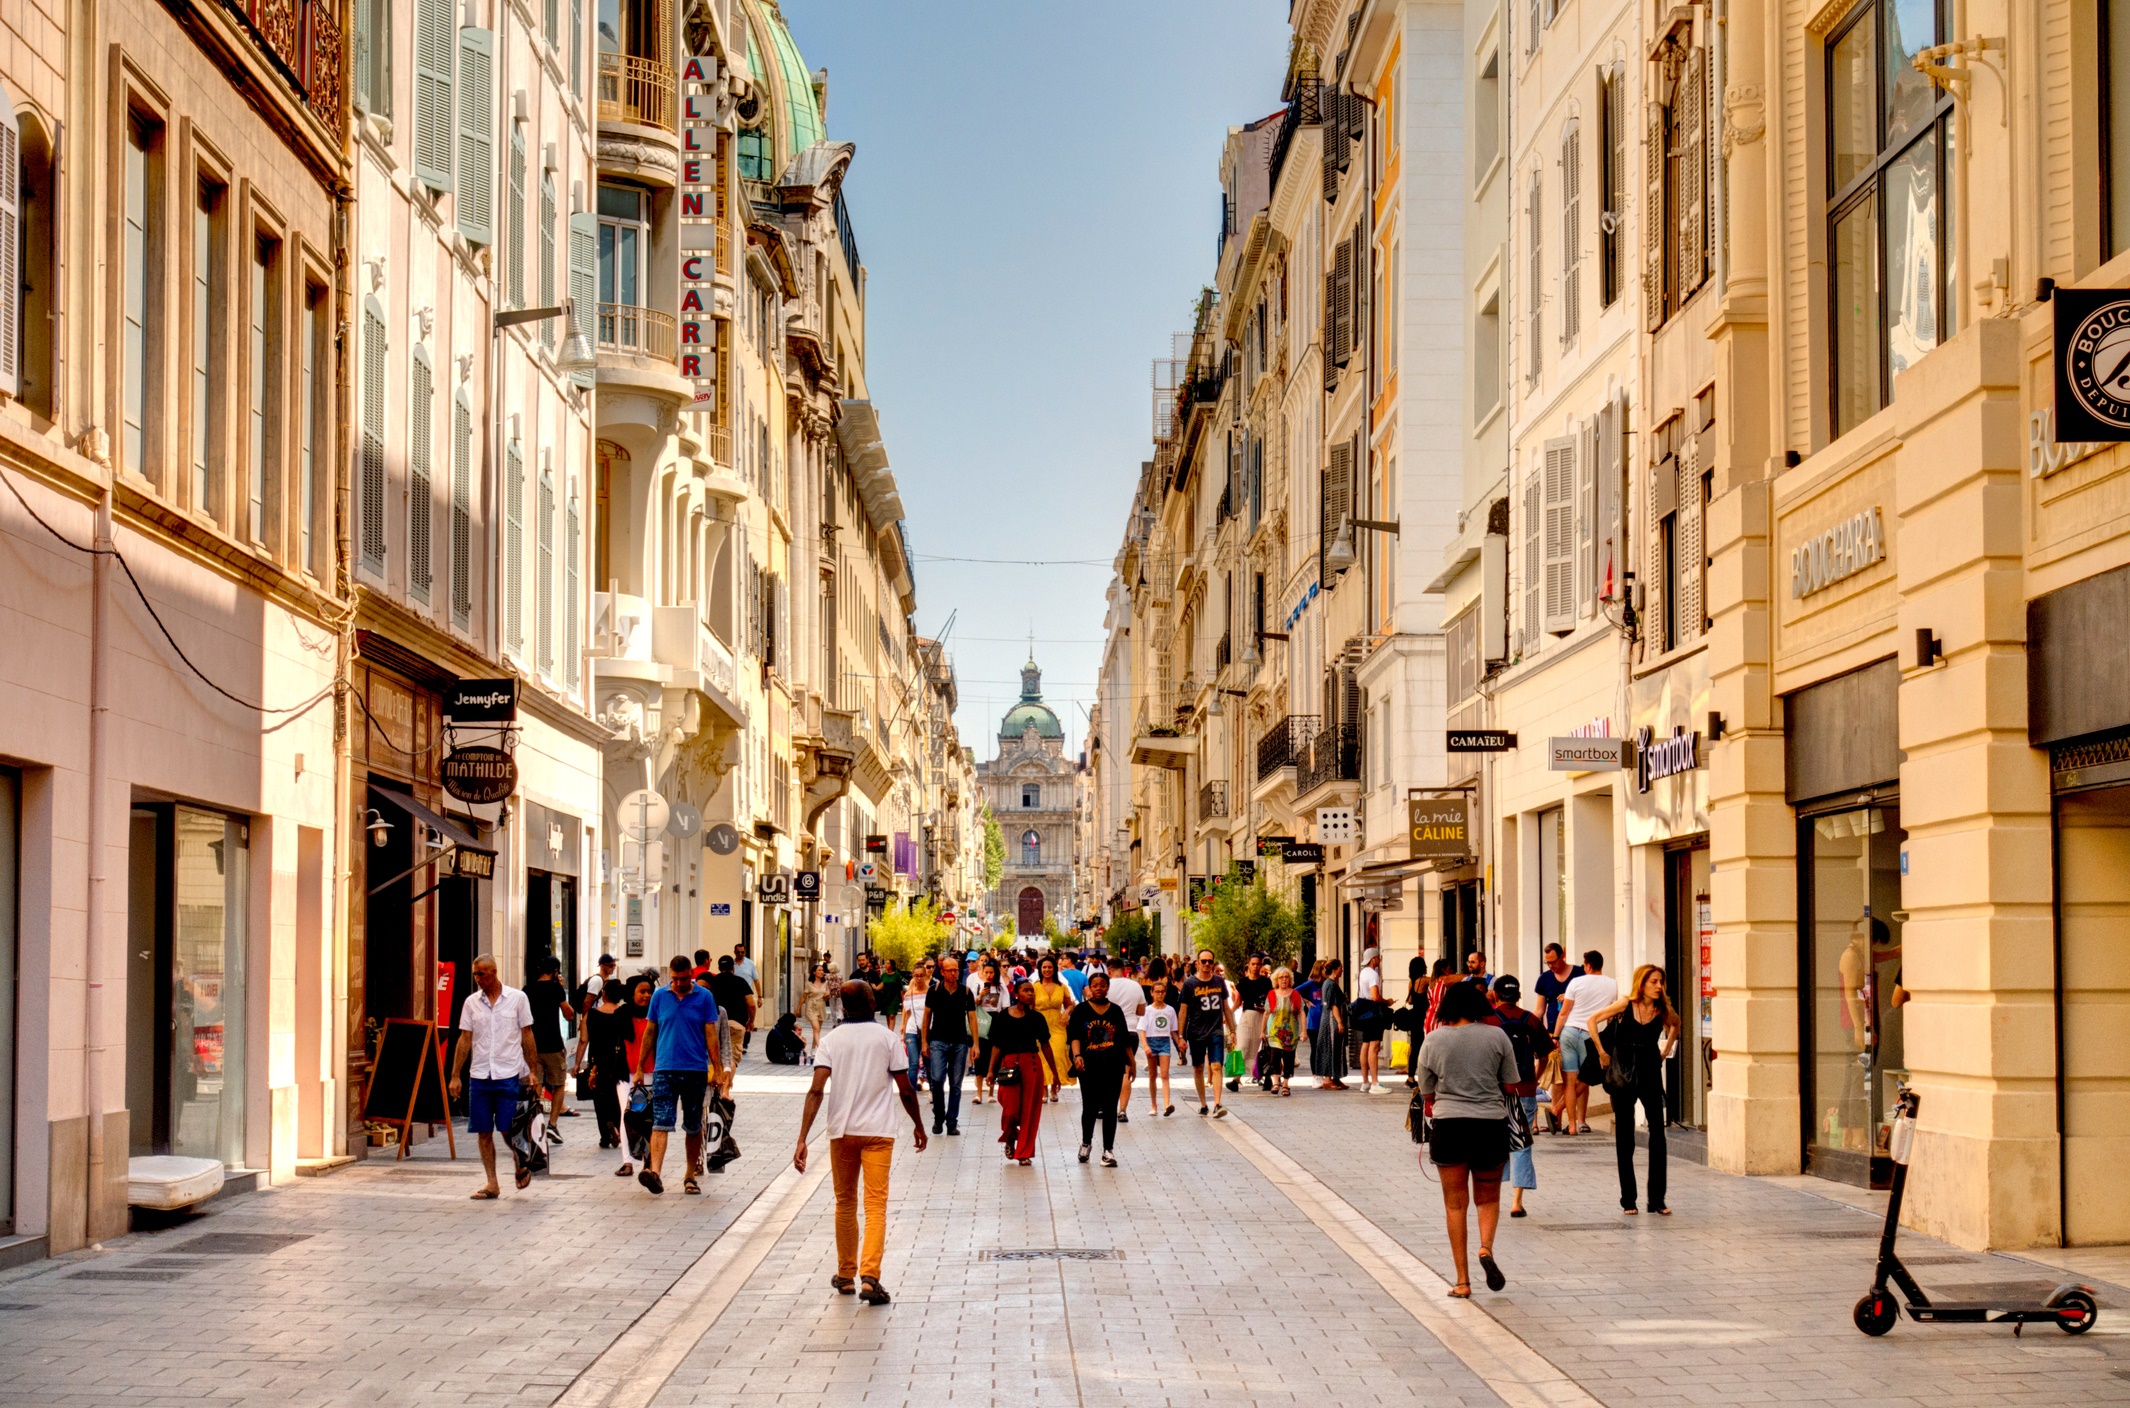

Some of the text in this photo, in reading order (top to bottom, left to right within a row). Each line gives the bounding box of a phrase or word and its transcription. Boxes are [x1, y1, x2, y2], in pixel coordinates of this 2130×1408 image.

[681, 58, 705, 377] ALLEN CARR
[2080, 377, 2128, 418] DEPUI
[1791, 507, 1880, 600] BOUCHARA
[454, 691, 511, 709] Jennyfer
[1450, 735, 1505, 747] CAMAÏEU
[1555, 747, 1618, 760] smartbox
[1648, 726, 1696, 781] smartbox
[447, 762, 513, 778] MATHILDE
[1414, 808, 1464, 824] la mie
[1413, 825, 1464, 840] CÂLINE
[1286, 849, 1318, 857] CAROLL
[762, 893, 787, 902] undiz
[868, 890, 884, 899] P&B
[1200, 995, 1220, 1011] 32
